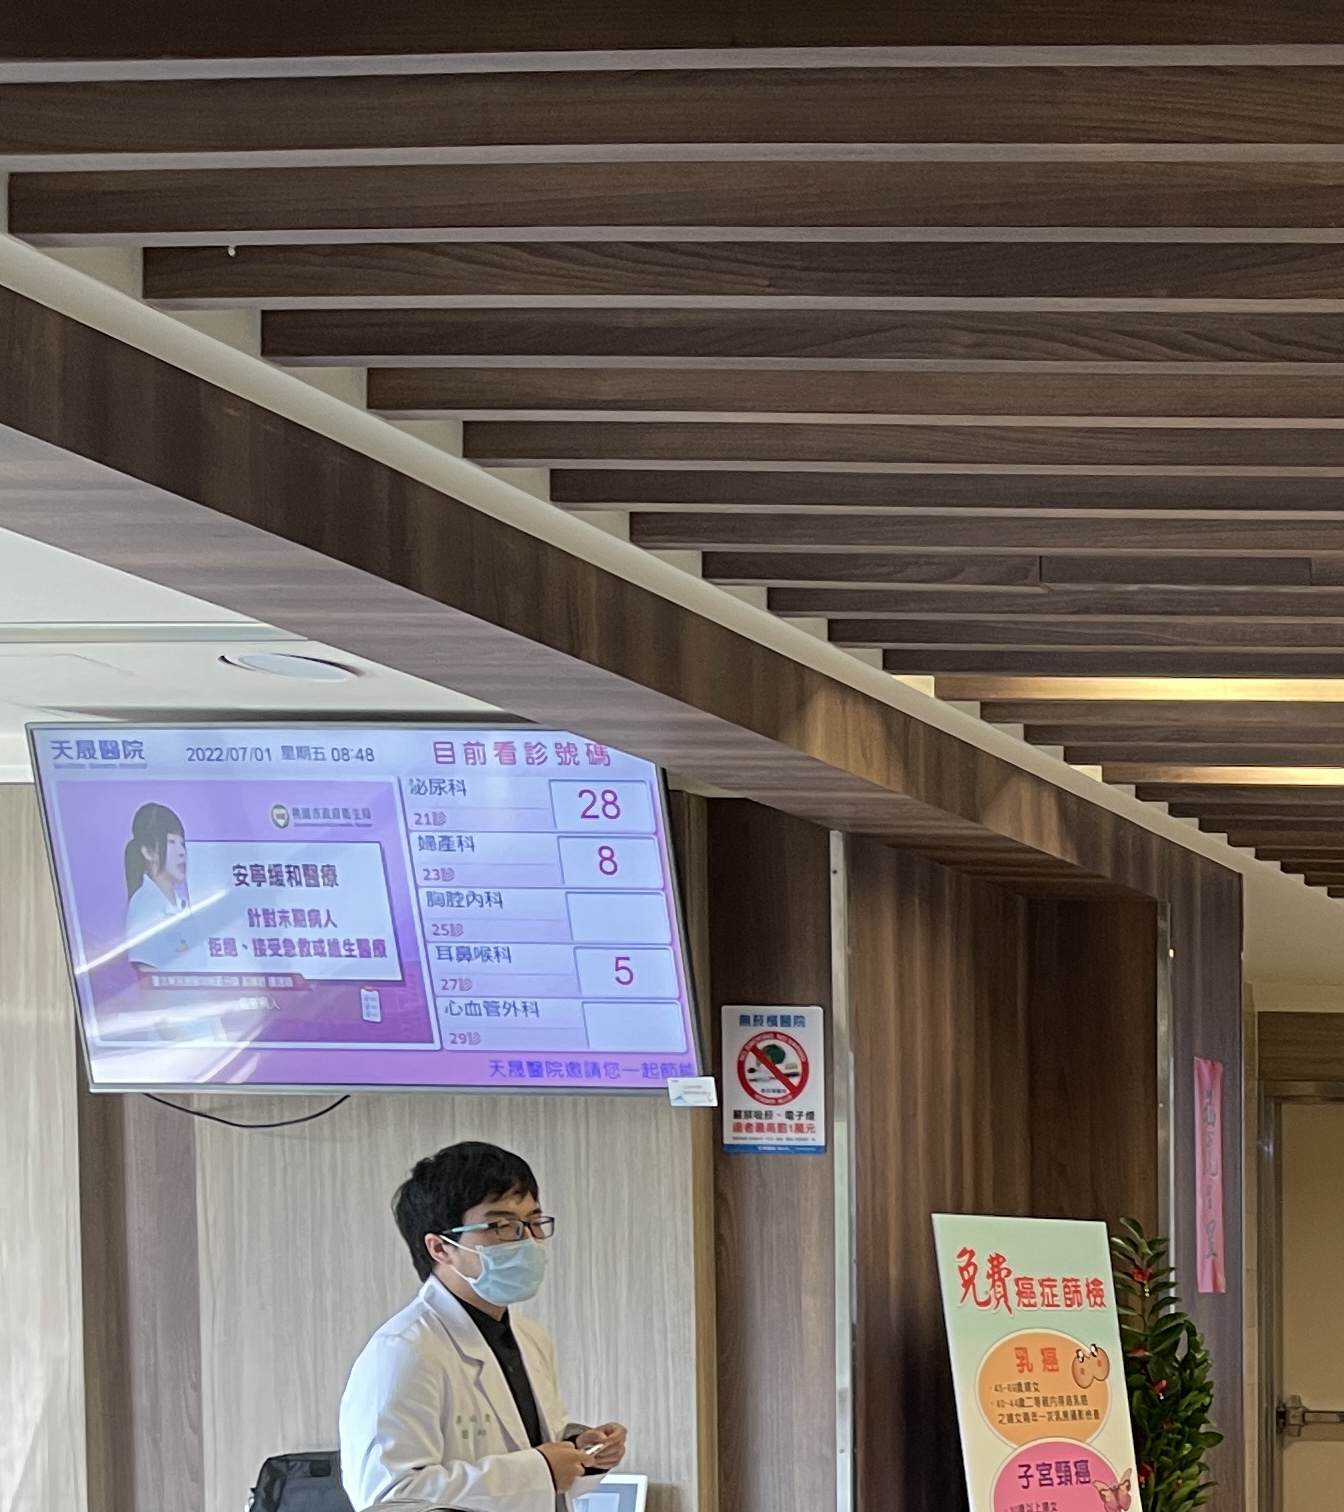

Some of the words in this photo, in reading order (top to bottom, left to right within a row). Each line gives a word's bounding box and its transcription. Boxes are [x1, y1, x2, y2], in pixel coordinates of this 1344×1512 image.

[50, 739, 146, 761] 天晟醫院
[186, 746, 272, 763] 2022/07/01
[280, 745, 327, 762] 星期五
[331, 746, 375, 763] 08:48
[433, 741, 612, 767] 目前看診號碼
[409, 778, 467, 797] 泌尿科
[578, 789, 622, 820] 28
[414, 811, 447, 826] 21診
[418, 835, 475, 853] 婦產科
[598, 845, 618, 876] 8
[232, 863, 339, 888] 安寧緩和醫療
[423, 867, 455, 882] 23診
[426, 890, 504, 909] 胸腔內科
[247, 908, 338, 928] 針對末期病人
[431, 923, 464, 937] 25診
[436, 945, 512, 964] 耳鼻喉科
[614, 956, 634, 986] 5
[440, 977, 473, 992] 27診
[445, 1000, 540, 1018] 心血管外科
[449, 1031, 481, 1045] 29診
[956, 1246, 1108, 1315] 免費癌症篩檢
[1013, 1346, 1060, 1374] 乳癌
[1017, 1459, 1092, 1490] 子宮頸癌
